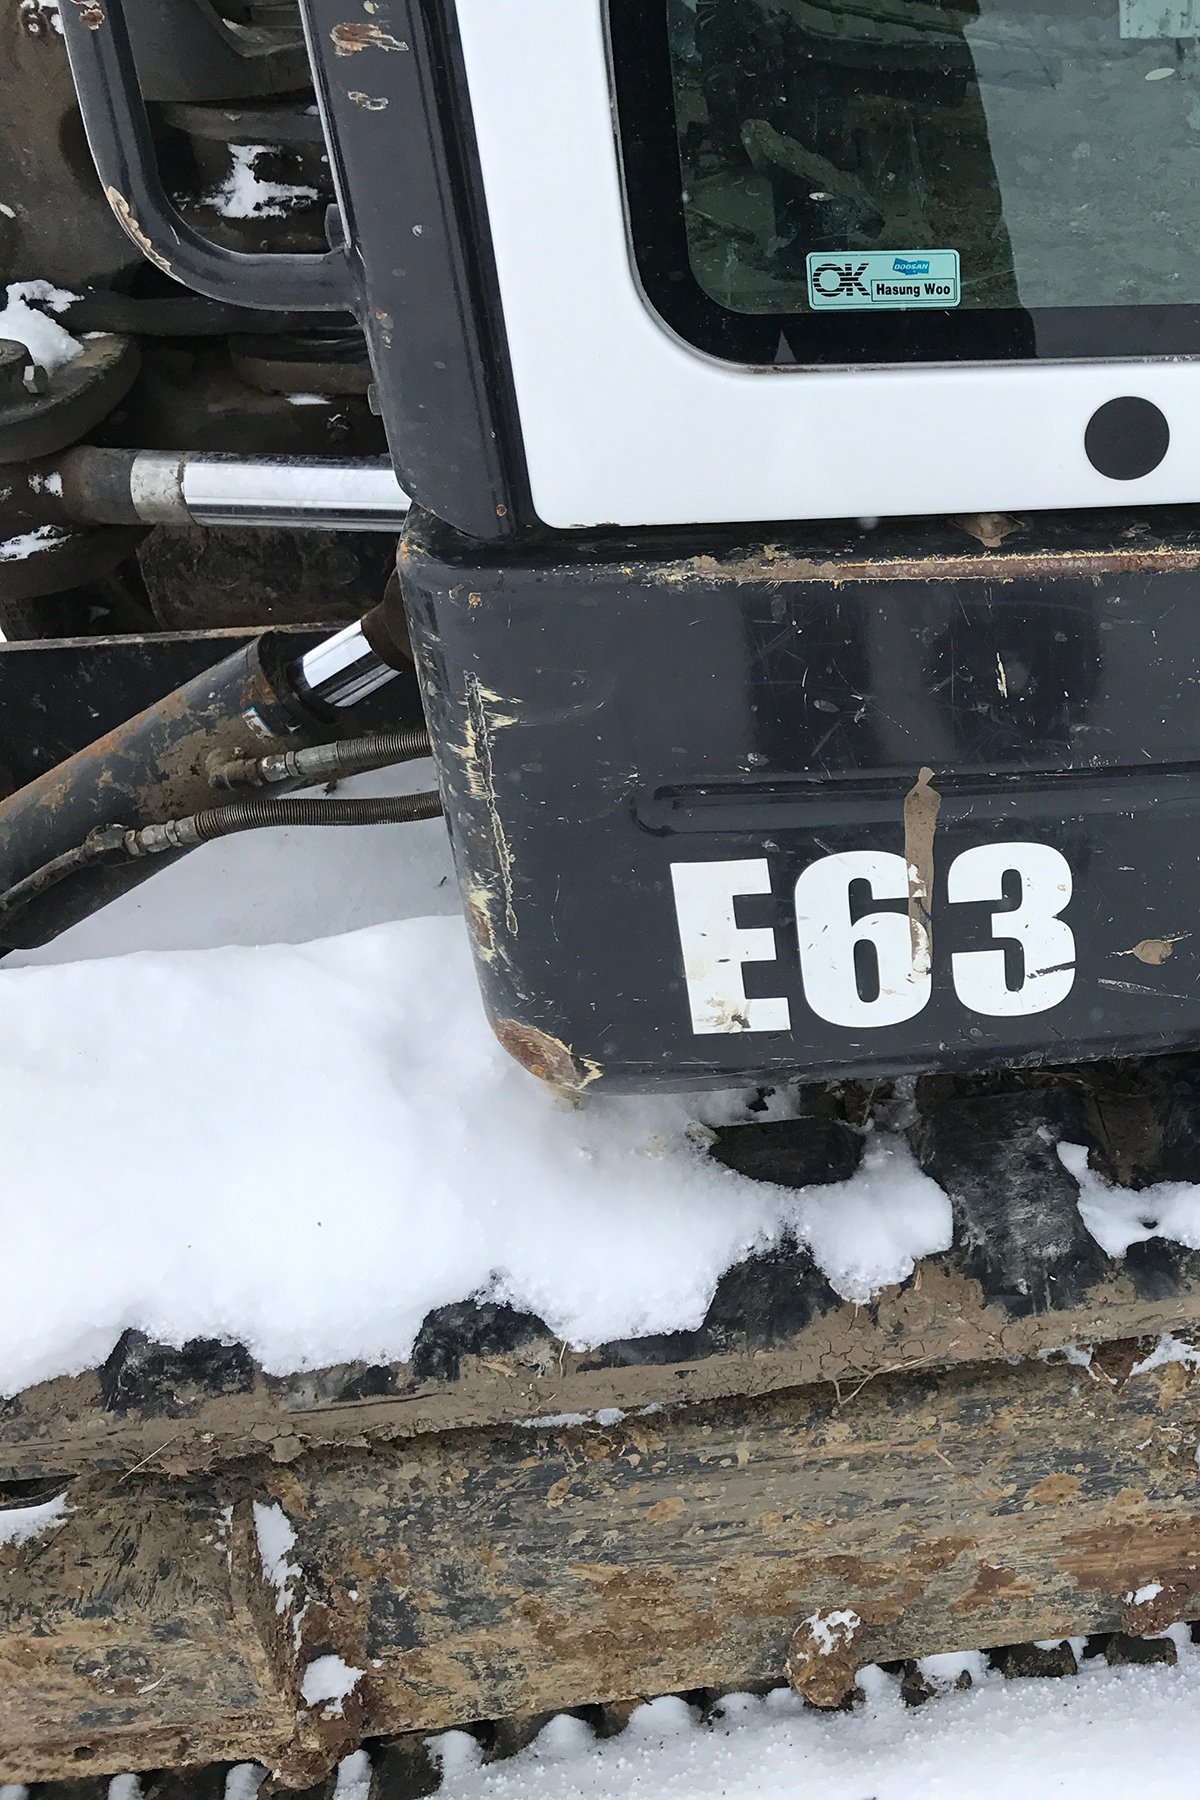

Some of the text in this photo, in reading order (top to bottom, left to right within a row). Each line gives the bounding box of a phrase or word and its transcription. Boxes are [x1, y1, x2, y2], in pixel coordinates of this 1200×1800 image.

[812, 262, 871, 298] OK
[876, 283, 950, 298] Hasung Woo
[669, 841, 1077, 1035] E63
